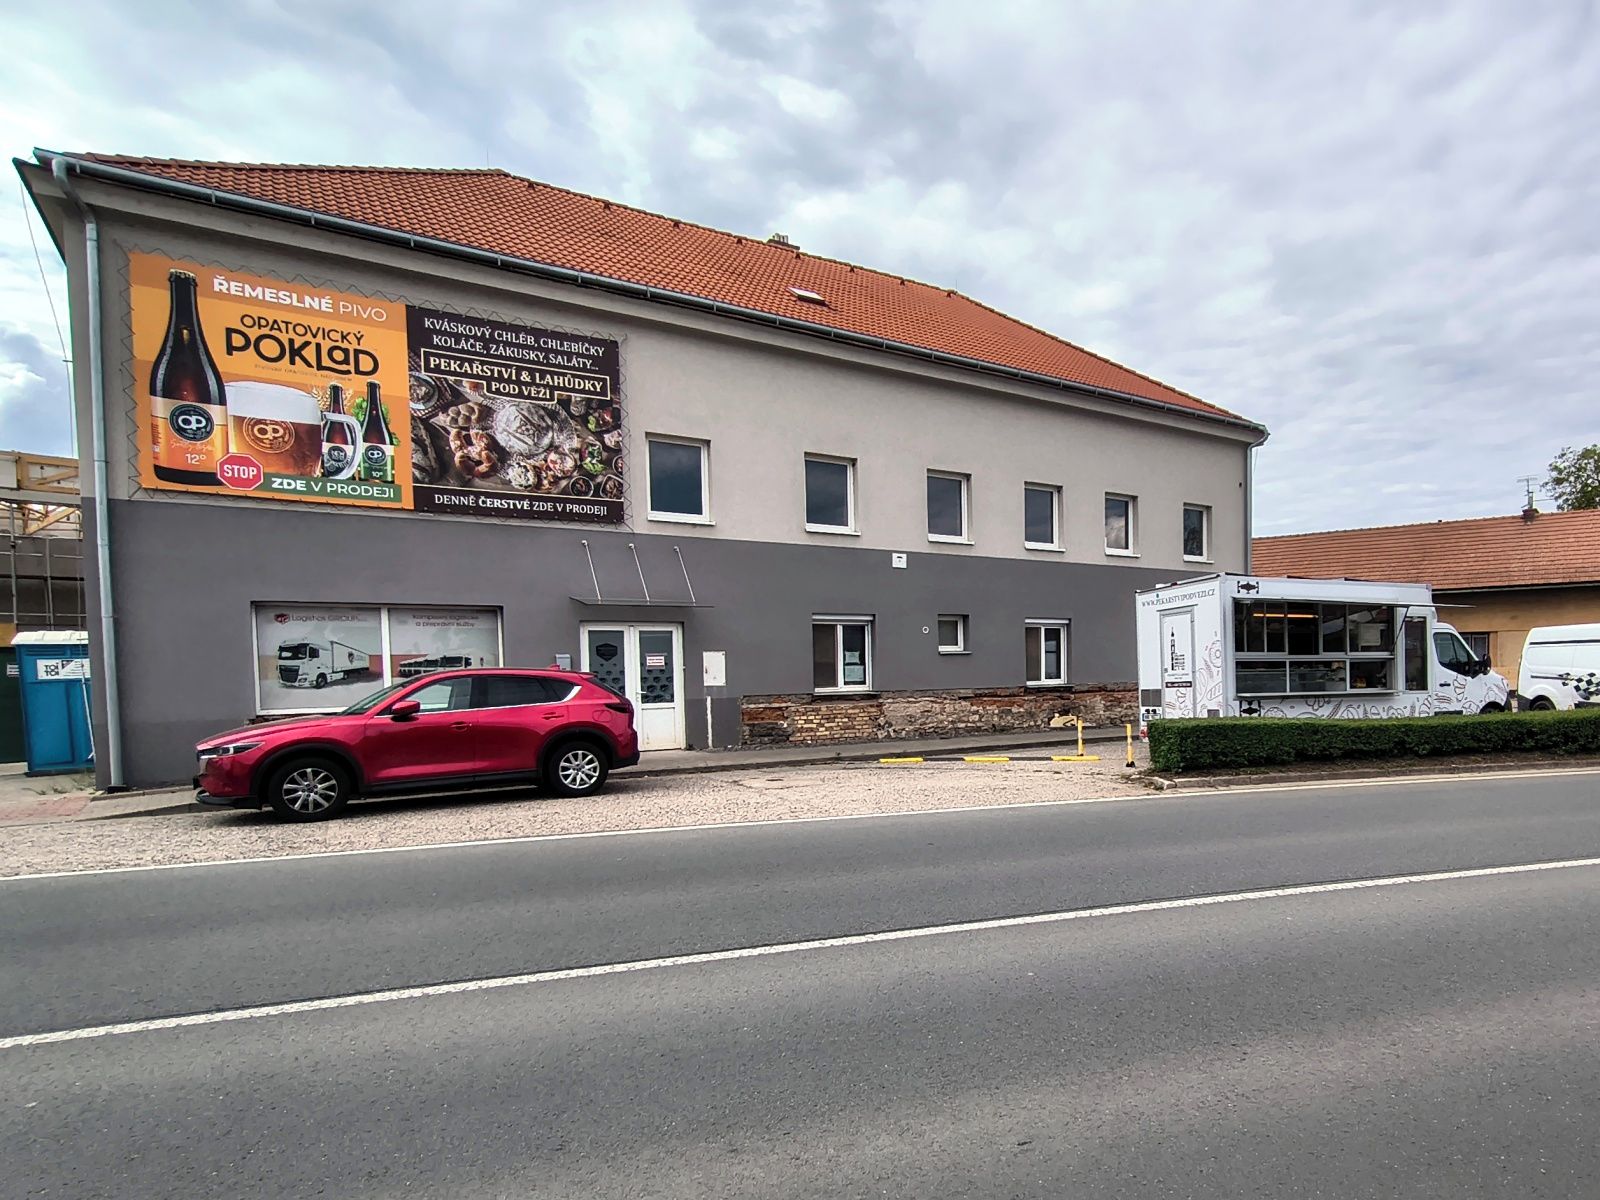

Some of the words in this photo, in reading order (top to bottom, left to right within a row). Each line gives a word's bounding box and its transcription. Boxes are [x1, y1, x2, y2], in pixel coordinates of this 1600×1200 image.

[213, 275, 334, 313] ŘEMESLNÉ
[339, 301, 387, 322] PIVO
[240, 314, 365, 347] OPATOVICKÝ
[424, 317, 492, 339] KVÁSKOVÝ
[494, 329, 538, 347] CHLÉB,
[540, 337, 605, 357] CHLEBÍČKY
[433, 335, 487, 354] KOLÁČE,
[489, 343, 547, 364] ZÁKUSKY,
[429, 356, 517, 381] PEKAŘSTVÍ
[520, 370, 531, 383] &
[535, 373, 603, 392] LAHŮDKY
[491, 381, 519, 395] POD
[223, 464, 257, 479] STOP
[271, 477, 307, 491] ZDE
[310, 481, 323, 492] V
[327, 483, 394, 498] PRODEJI
[434, 494, 477, 507] DENNĚ
[478, 496, 531, 510] ČERSTVÉ
[532, 502, 554, 512] ZDE
[555, 503, 564, 512] V
[566, 504, 607, 516] PRODEJI
